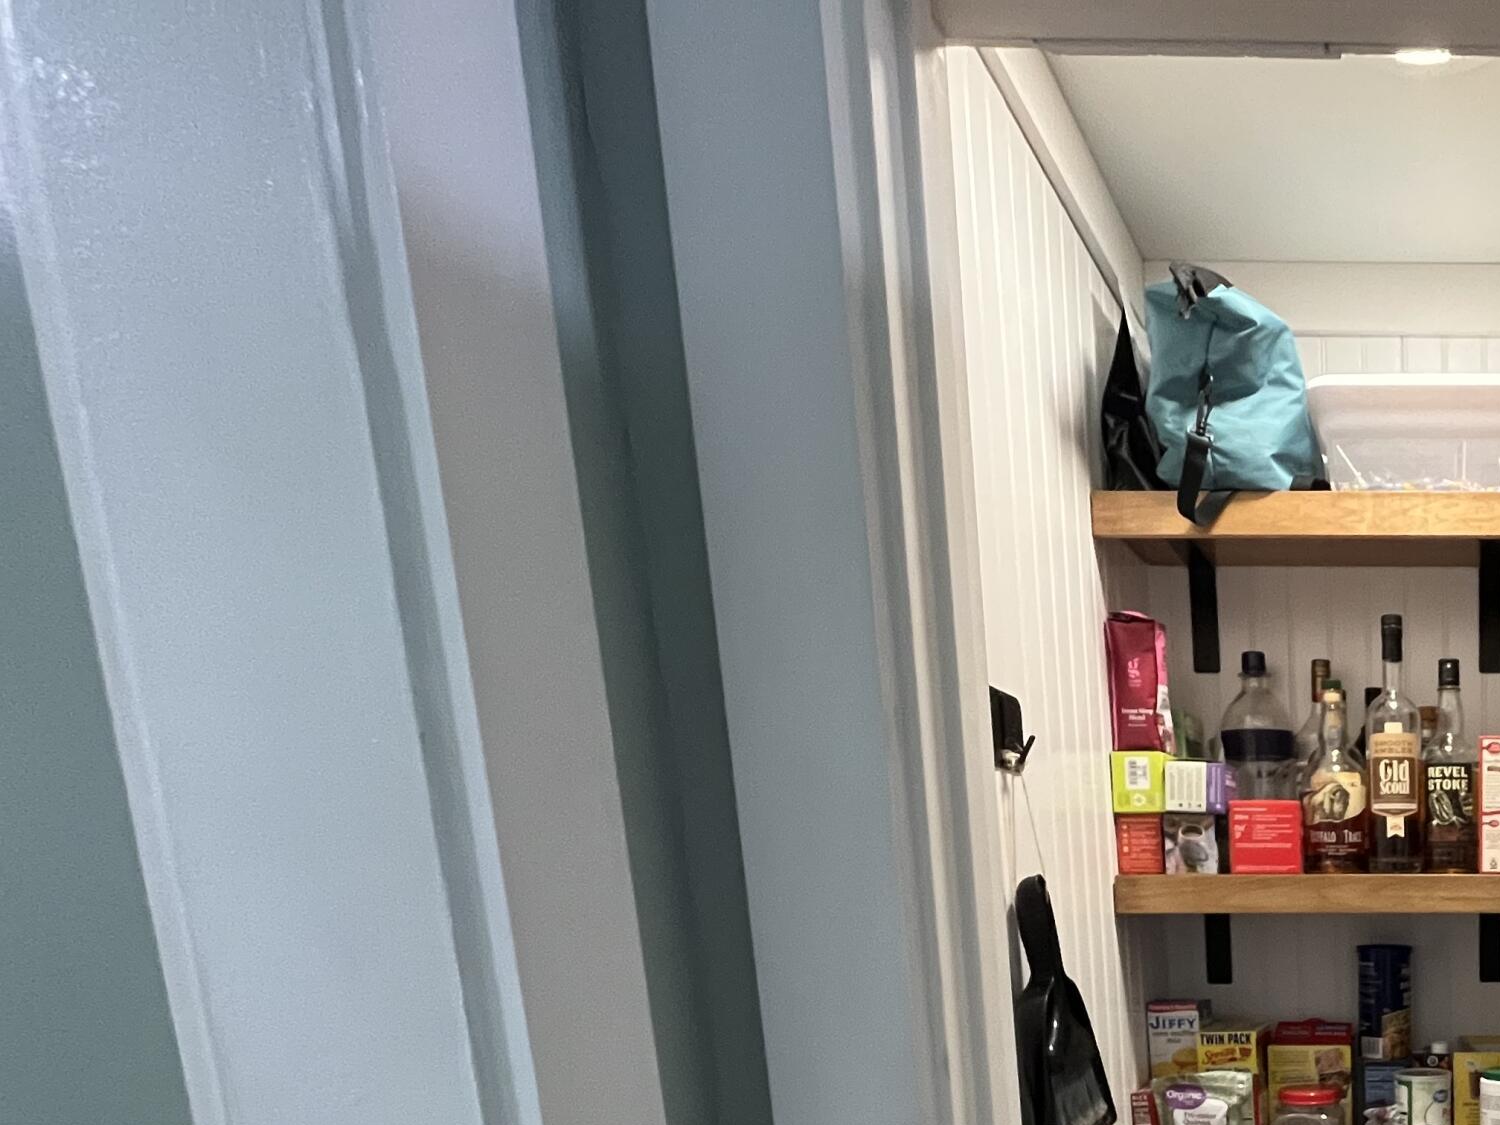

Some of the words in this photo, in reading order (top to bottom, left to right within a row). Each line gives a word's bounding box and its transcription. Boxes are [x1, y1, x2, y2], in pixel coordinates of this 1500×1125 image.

[1379, 759, 1410, 782] Old
[1427, 766, 1468, 778] REVEL
[1427, 779, 1468, 791] STOKE
[1148, 1017, 1196, 1030] JIFFY
[1200, 1033, 1225, 1045] TWIN
[1228, 1033, 1252, 1045] PACK
